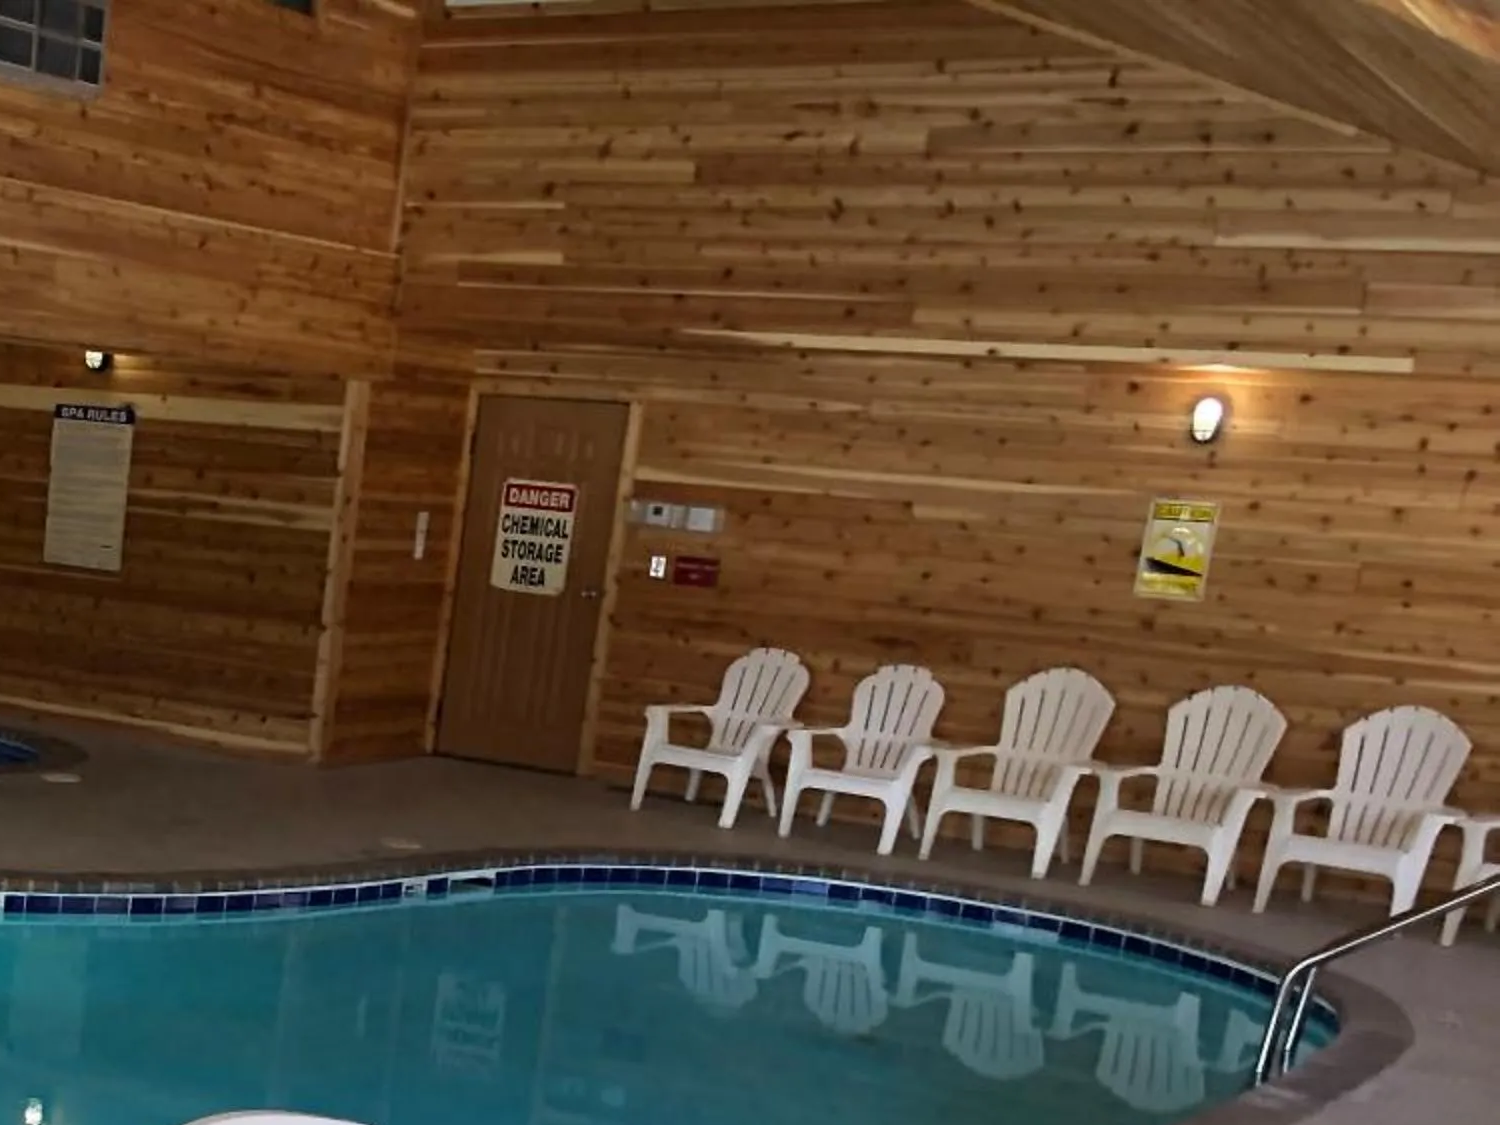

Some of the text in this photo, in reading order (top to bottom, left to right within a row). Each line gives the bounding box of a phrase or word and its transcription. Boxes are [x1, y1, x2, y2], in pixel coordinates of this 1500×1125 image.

[61, 407, 127, 422] SPA RULES
[509, 487, 571, 509] DANGER
[501, 513, 568, 539] CHEMICAL
[501, 539, 564, 564] STORAGE
[510, 564, 546, 587] AREA
